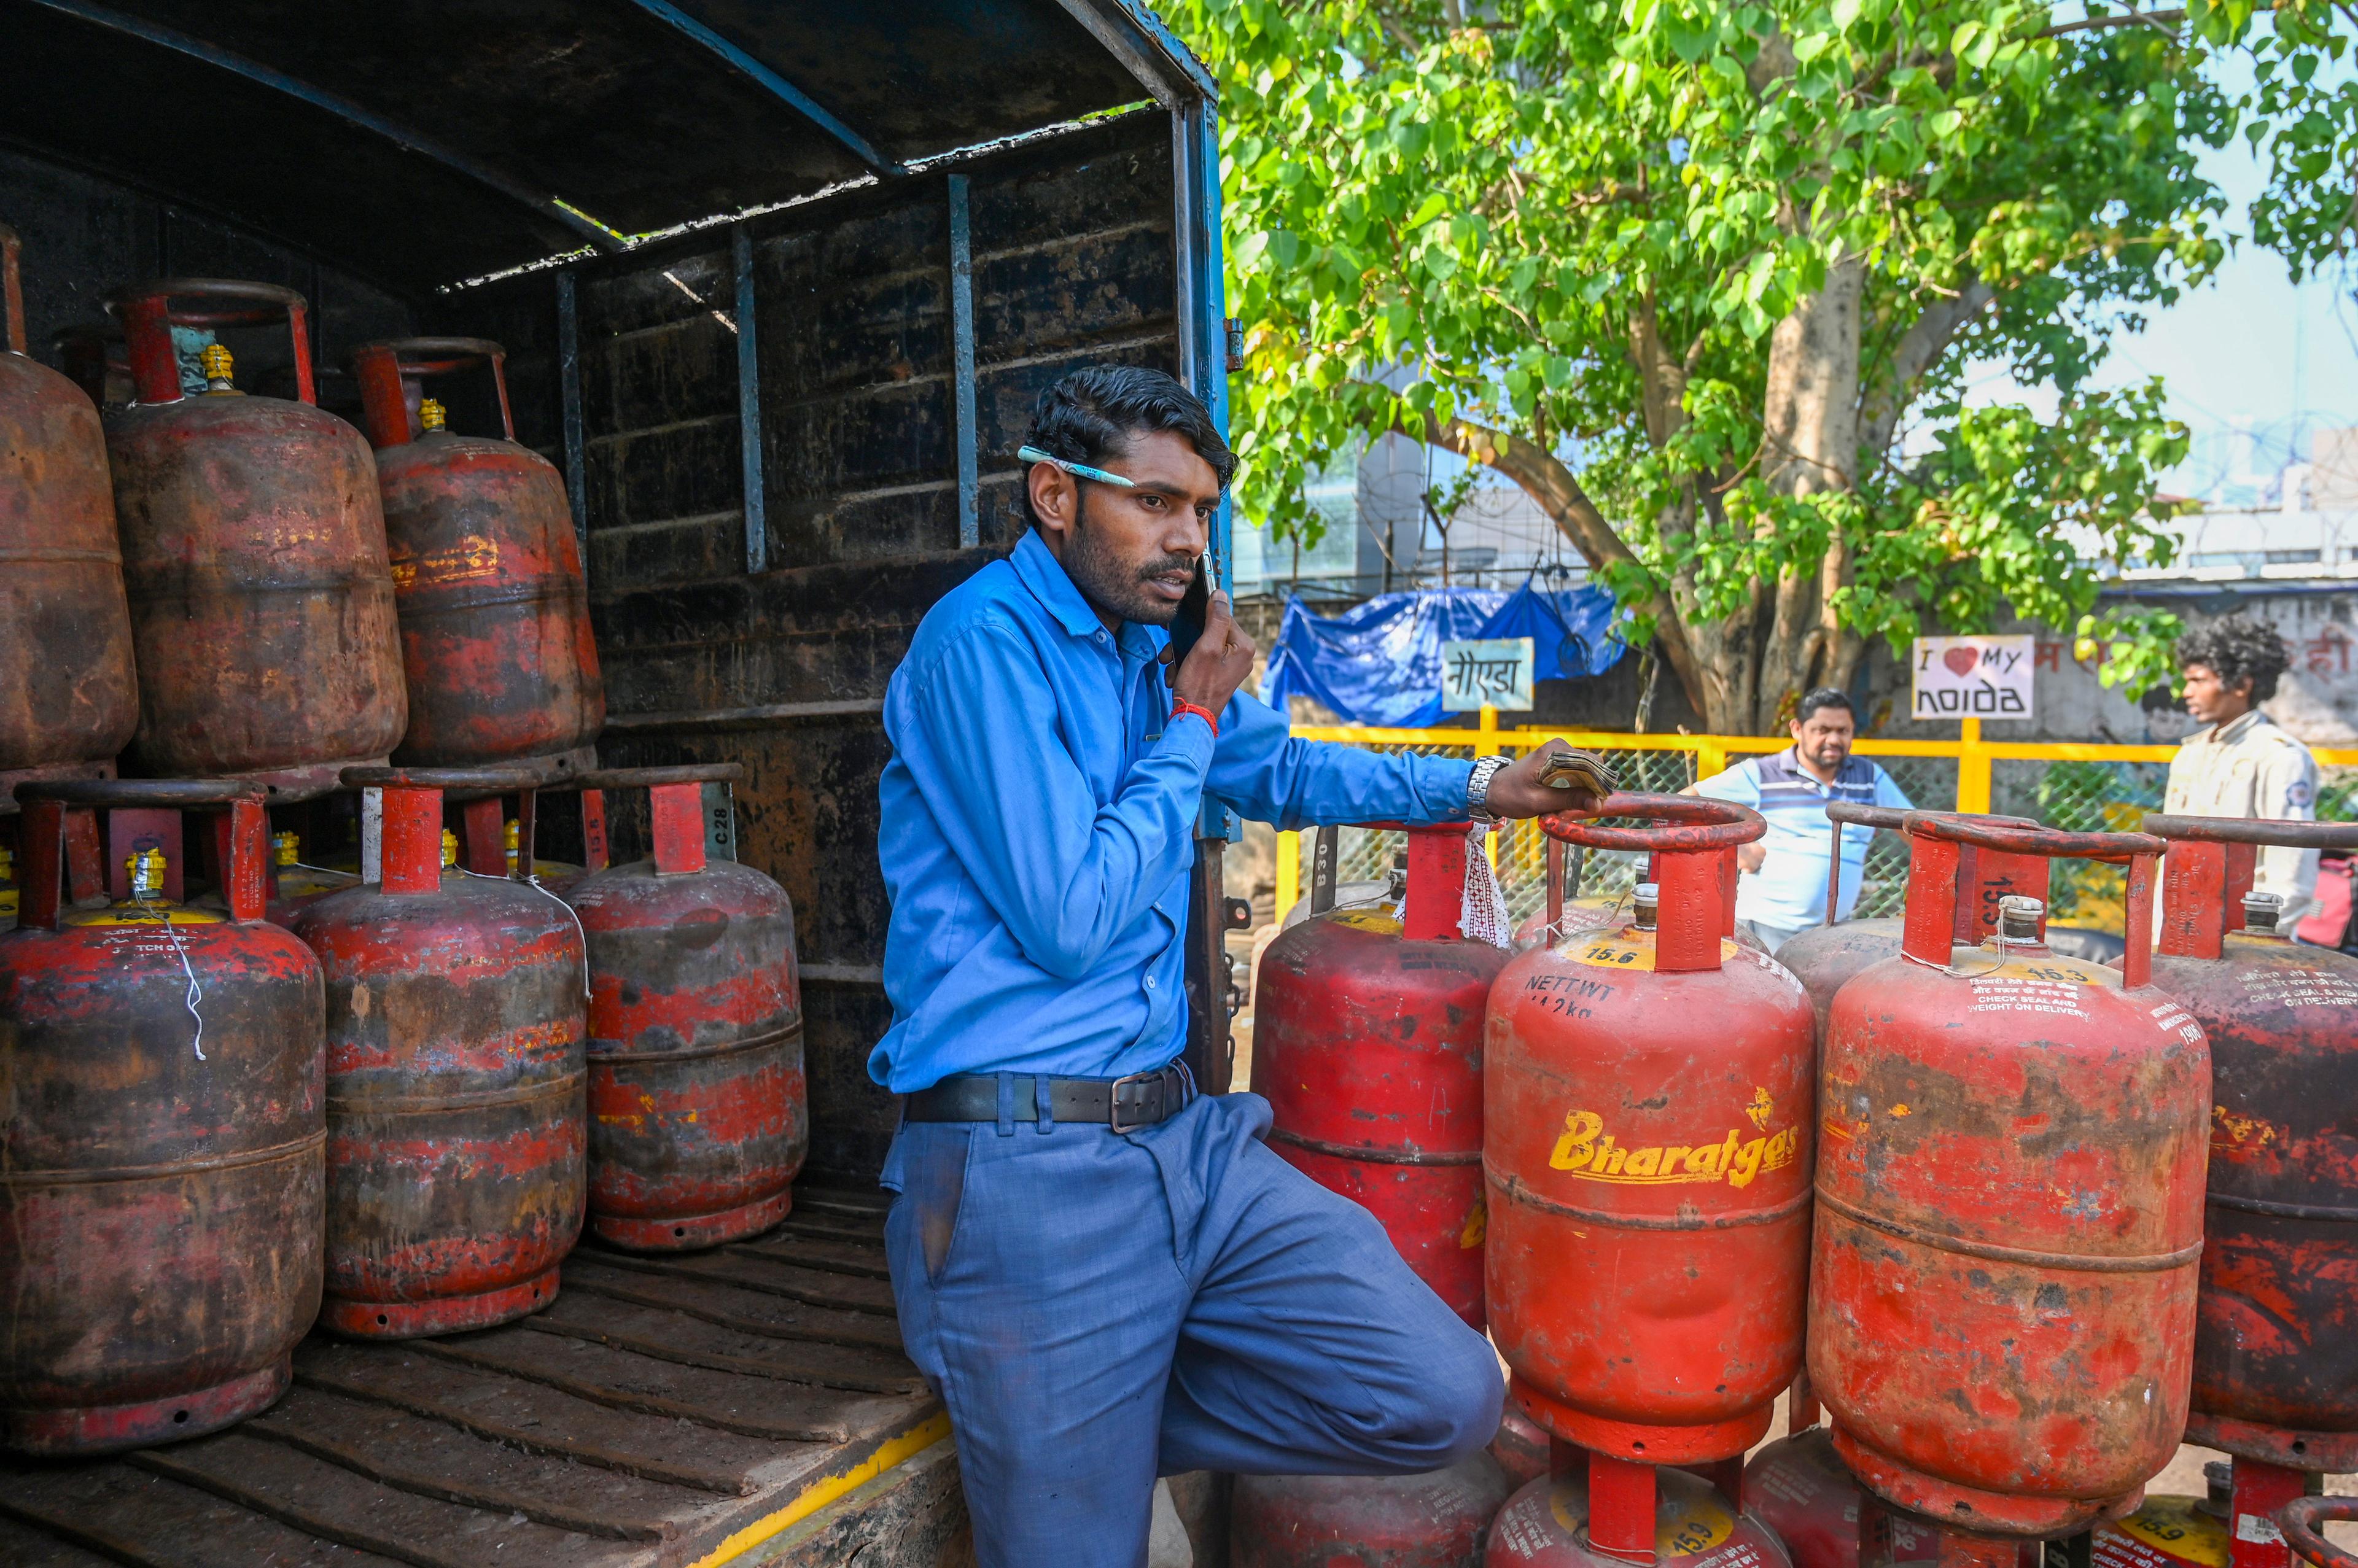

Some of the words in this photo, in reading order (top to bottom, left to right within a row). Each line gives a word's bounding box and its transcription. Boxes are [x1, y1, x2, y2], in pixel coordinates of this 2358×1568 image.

[1919, 650, 1932, 670] I
[714, 807, 728, 845] C28
[1317, 844, 1328, 888] B30
[1586, 947, 1638, 964] 15.6
[2028, 968, 2088, 982] 15.3
[2294, 988, 2324, 997] SEAL
[1967, 1003, 2012, 1012] WEIGHT
[2020, 996, 2050, 1004] SEAL
[2052, 999, 2077, 1008] AND
[2284, 998, 2303, 1007] ON
[2178, 1023, 2201, 1045] 1906
[1549, 1109, 1799, 1189] Bharatgas
[1672, 1522, 1713, 1556] 15.9
[2093, 1552, 2126, 1568] CHECK
